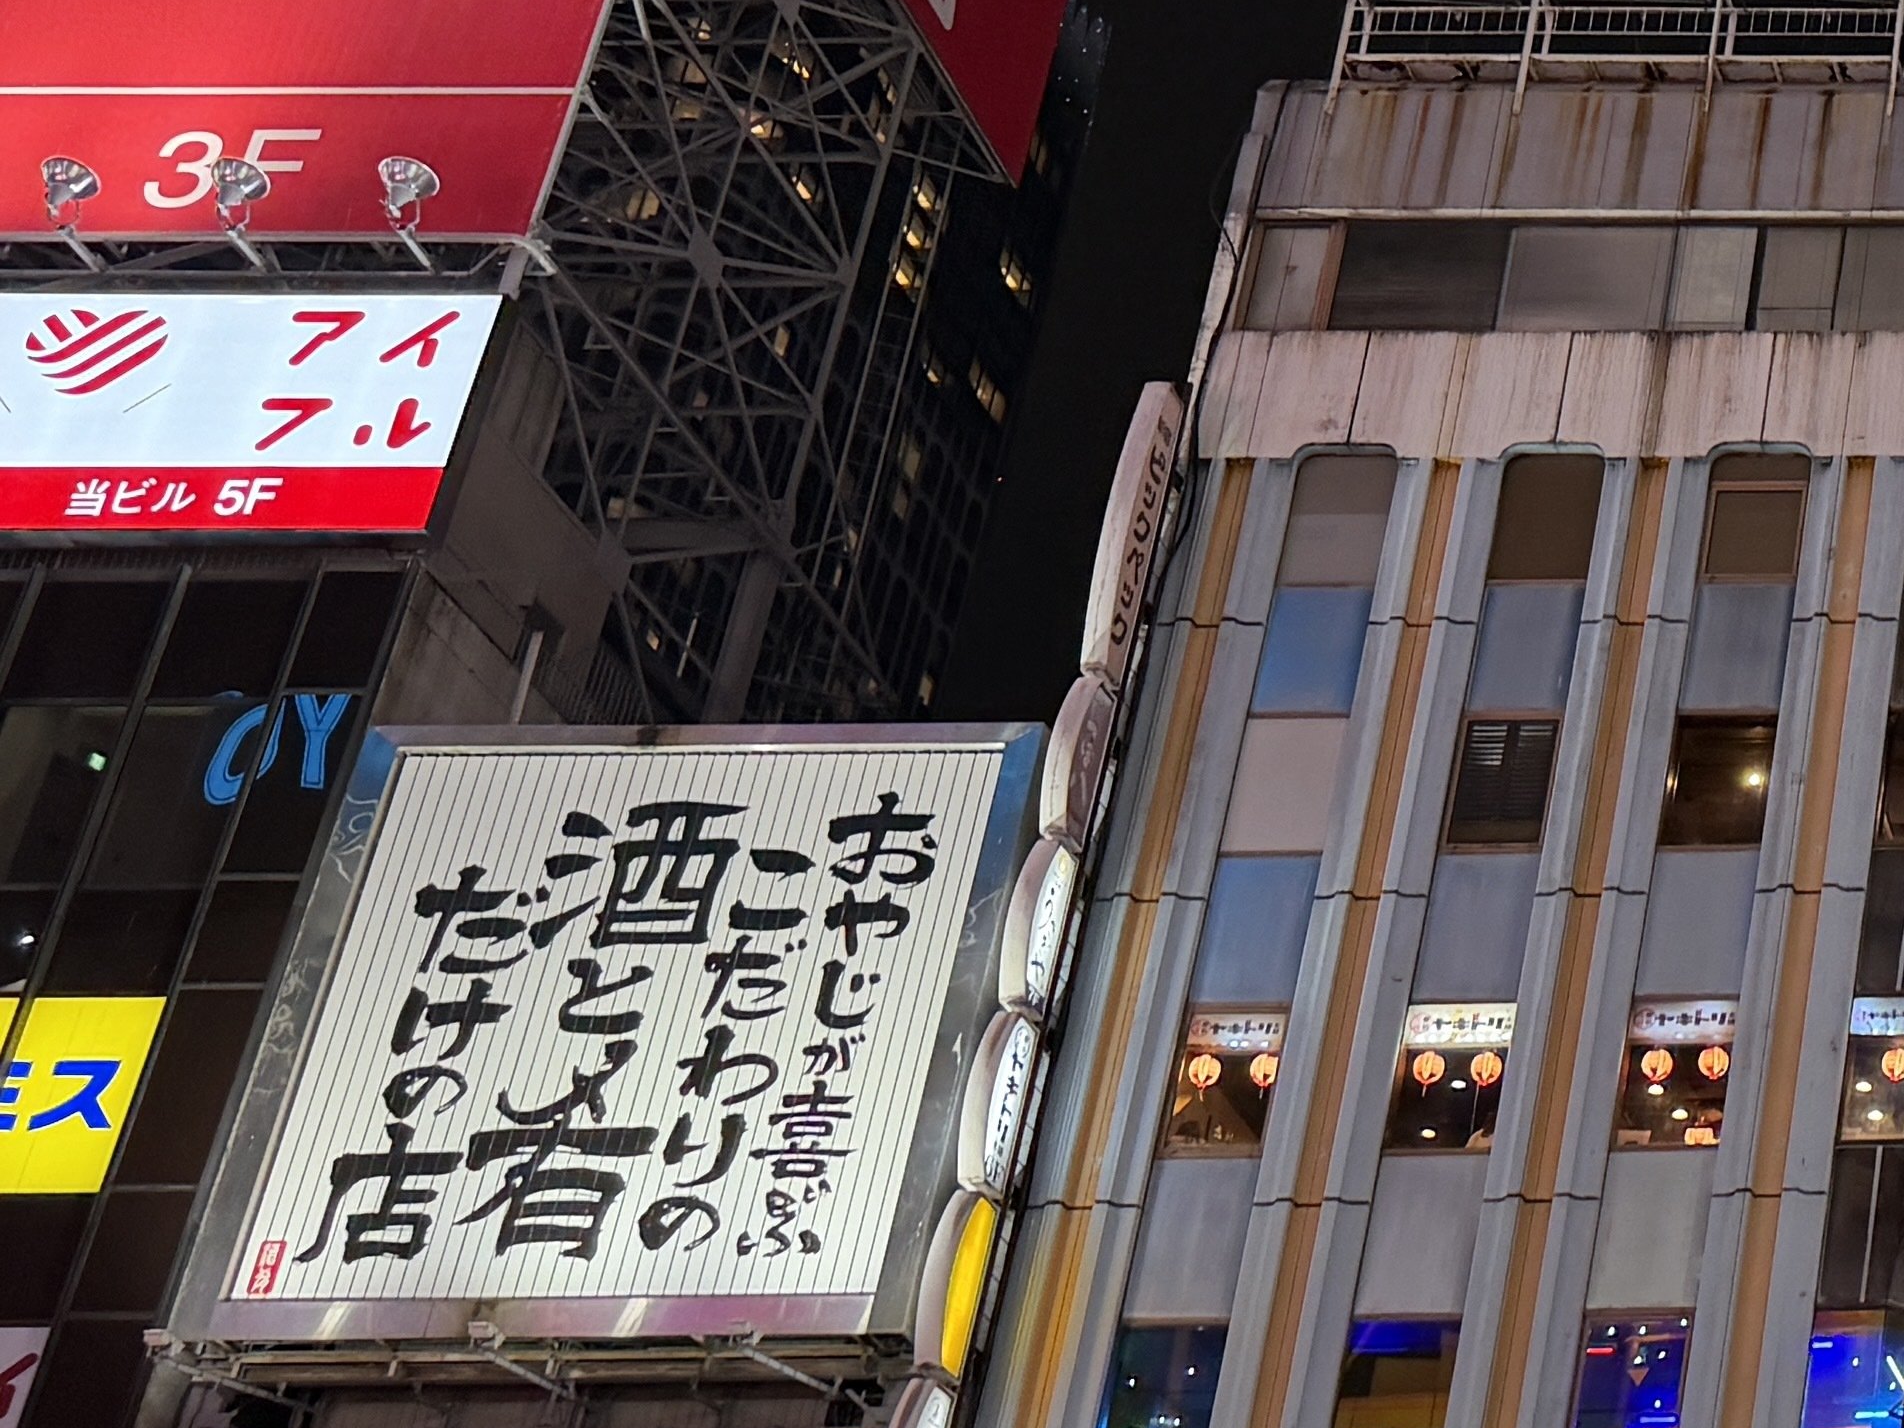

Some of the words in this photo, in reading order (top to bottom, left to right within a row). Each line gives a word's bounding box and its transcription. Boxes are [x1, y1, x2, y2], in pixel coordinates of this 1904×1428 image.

[142, 128, 322, 209] 3F
[287, 310, 462, 369] アイ
[63, 476, 195, 517] 当ビル
[212, 476, 283, 516] 5F
[292, 865, 537, 1265] だけの店
[638, 847, 814, 1252] こだわりの
[736, 791, 937, 1260] おやじが喜ぶ
[0, 1058, 123, 1135] ス
